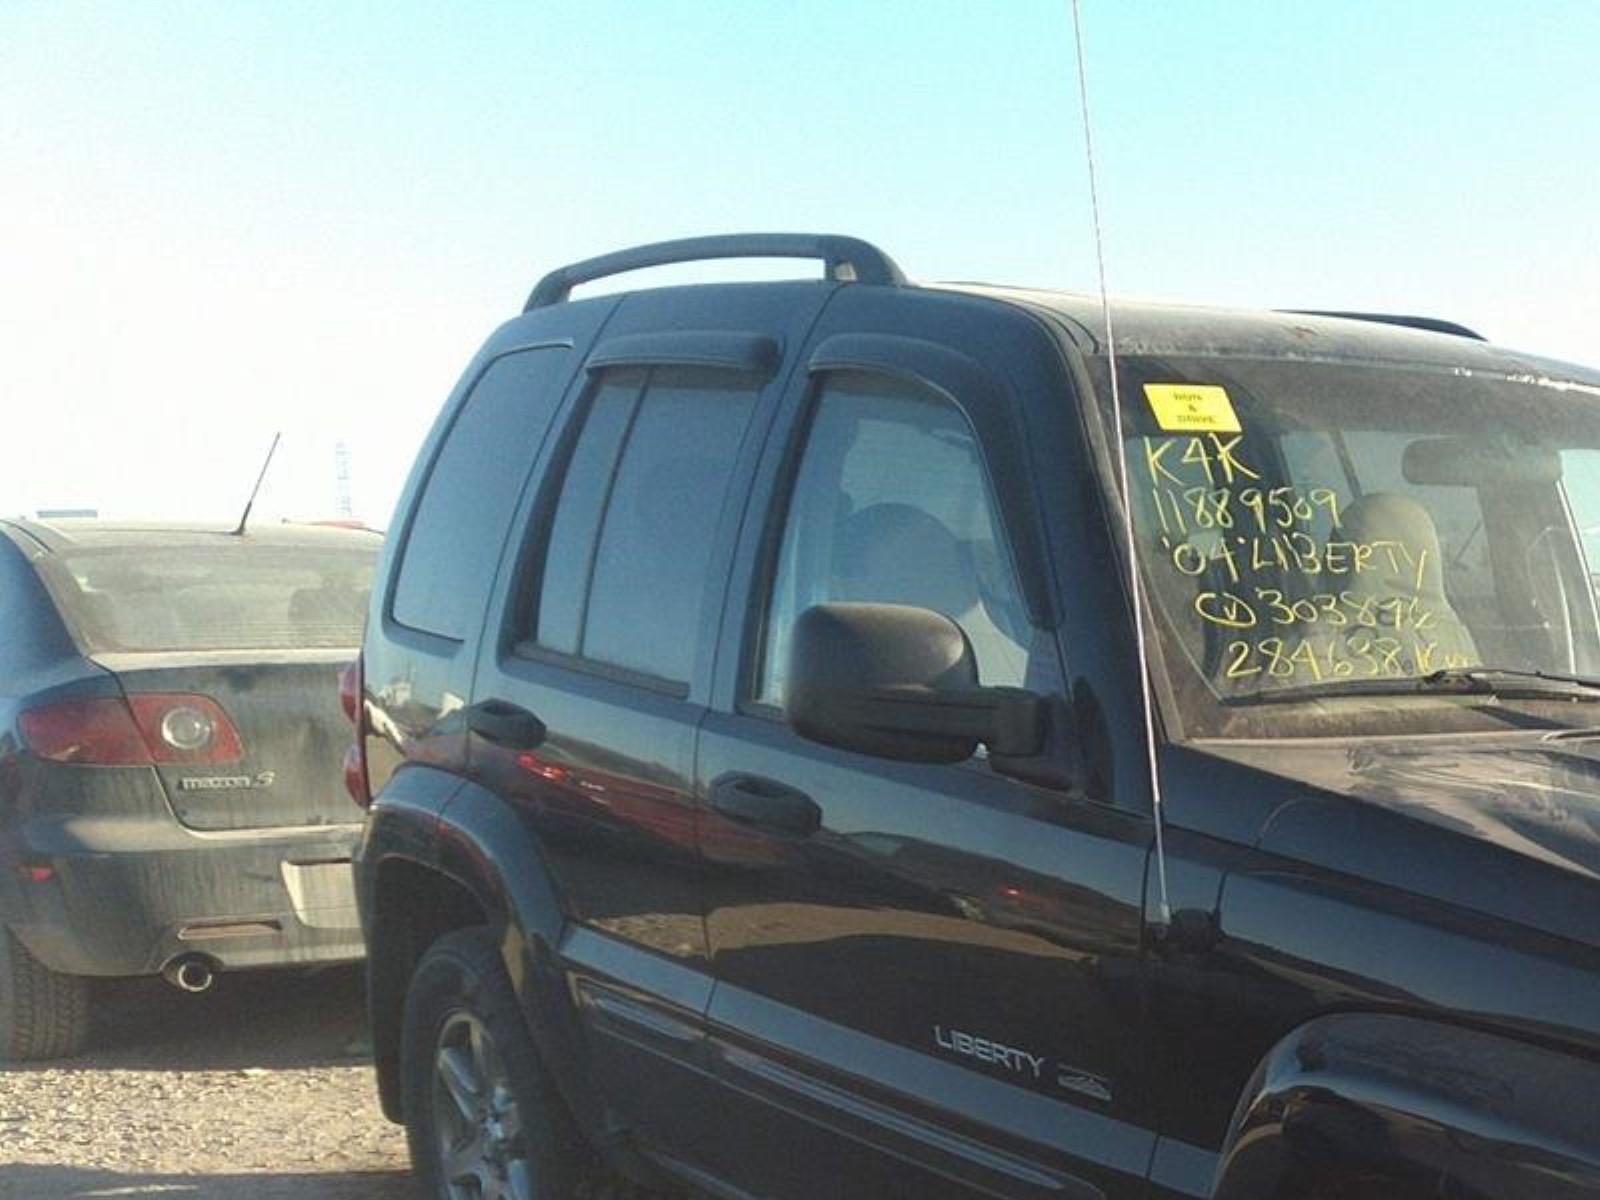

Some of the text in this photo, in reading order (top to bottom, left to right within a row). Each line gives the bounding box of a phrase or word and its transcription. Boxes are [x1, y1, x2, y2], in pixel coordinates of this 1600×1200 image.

[1143, 432, 1262, 487] K4K
[1152, 487, 1342, 535] 11889509
[933, 1023, 1046, 1078] LIBERTY
